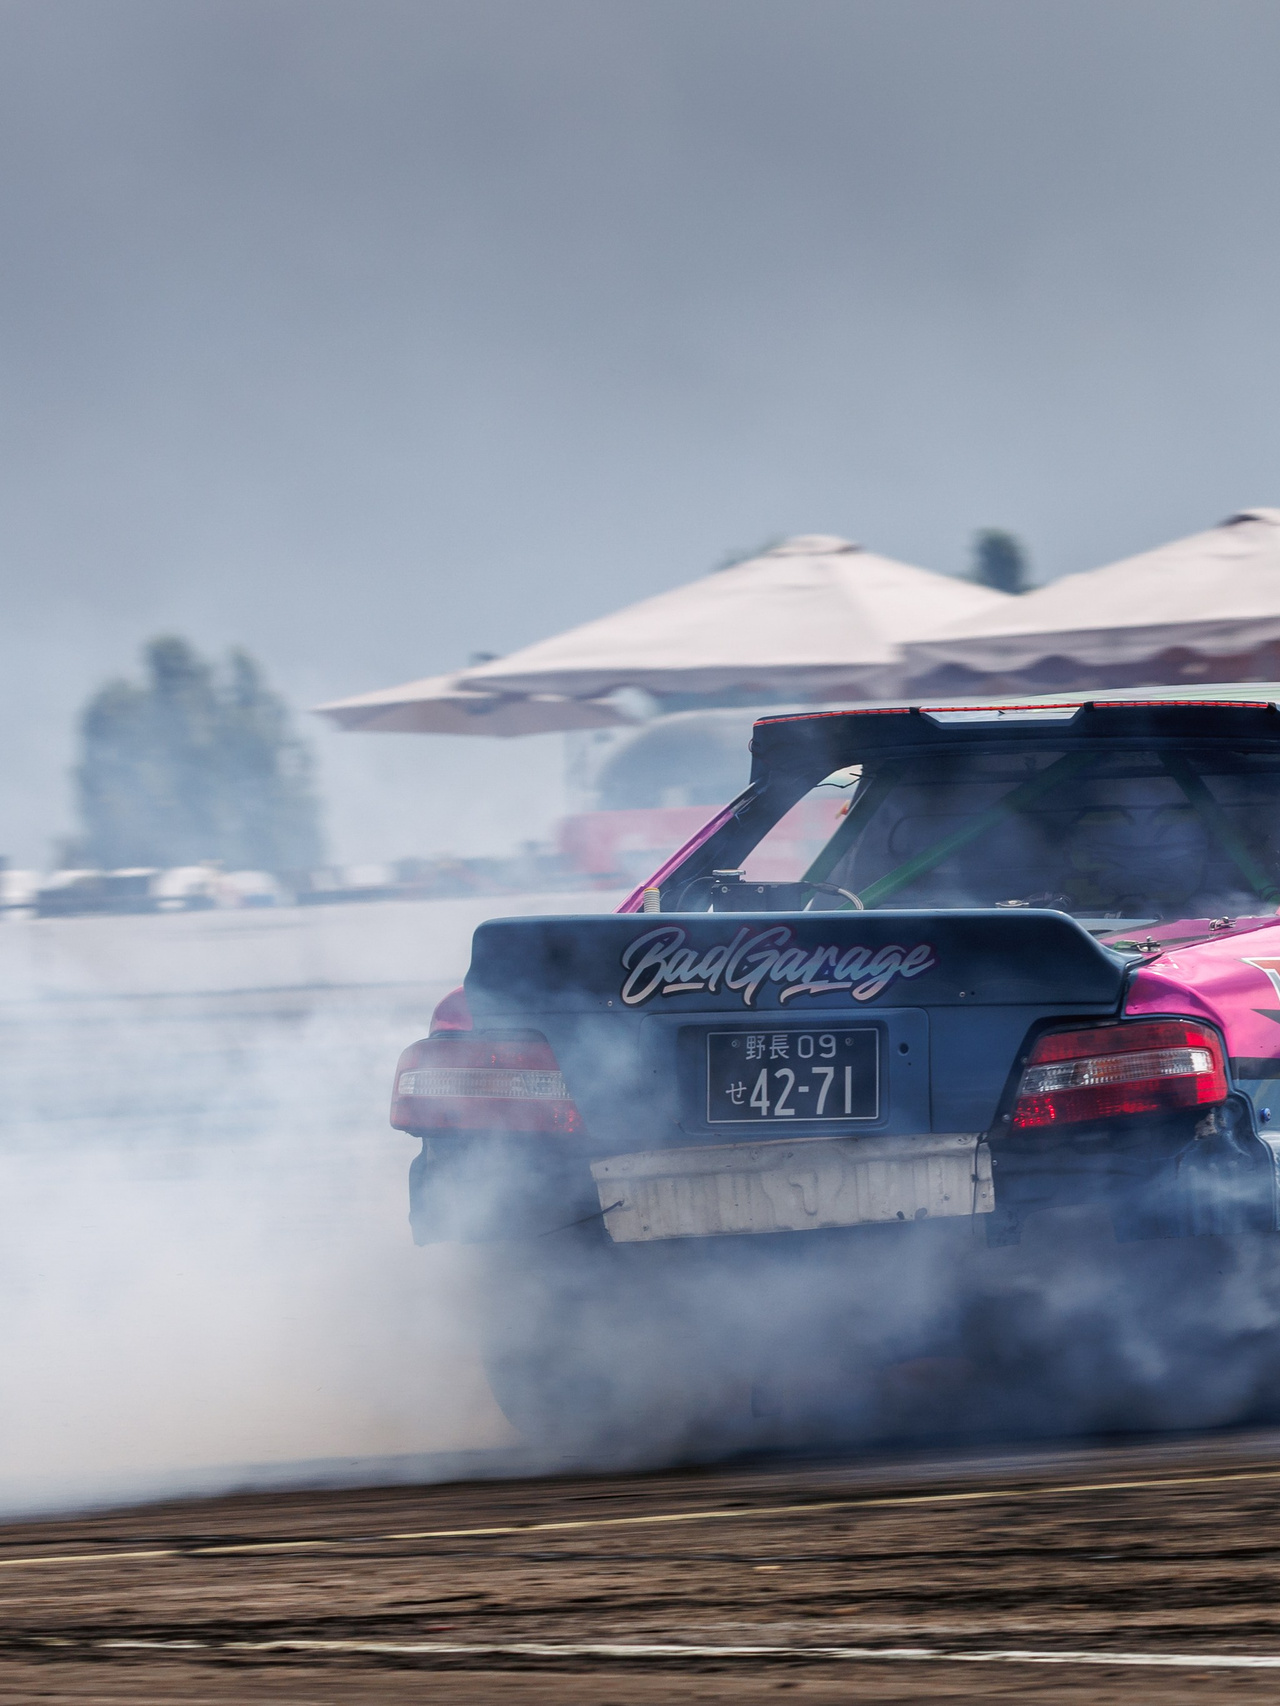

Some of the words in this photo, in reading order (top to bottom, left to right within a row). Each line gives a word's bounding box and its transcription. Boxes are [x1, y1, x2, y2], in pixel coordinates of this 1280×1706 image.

[797, 1034, 837, 1059] 09
[726, 1081, 747, 1105] せ
[750, 1066, 852, 1116] 42-71
